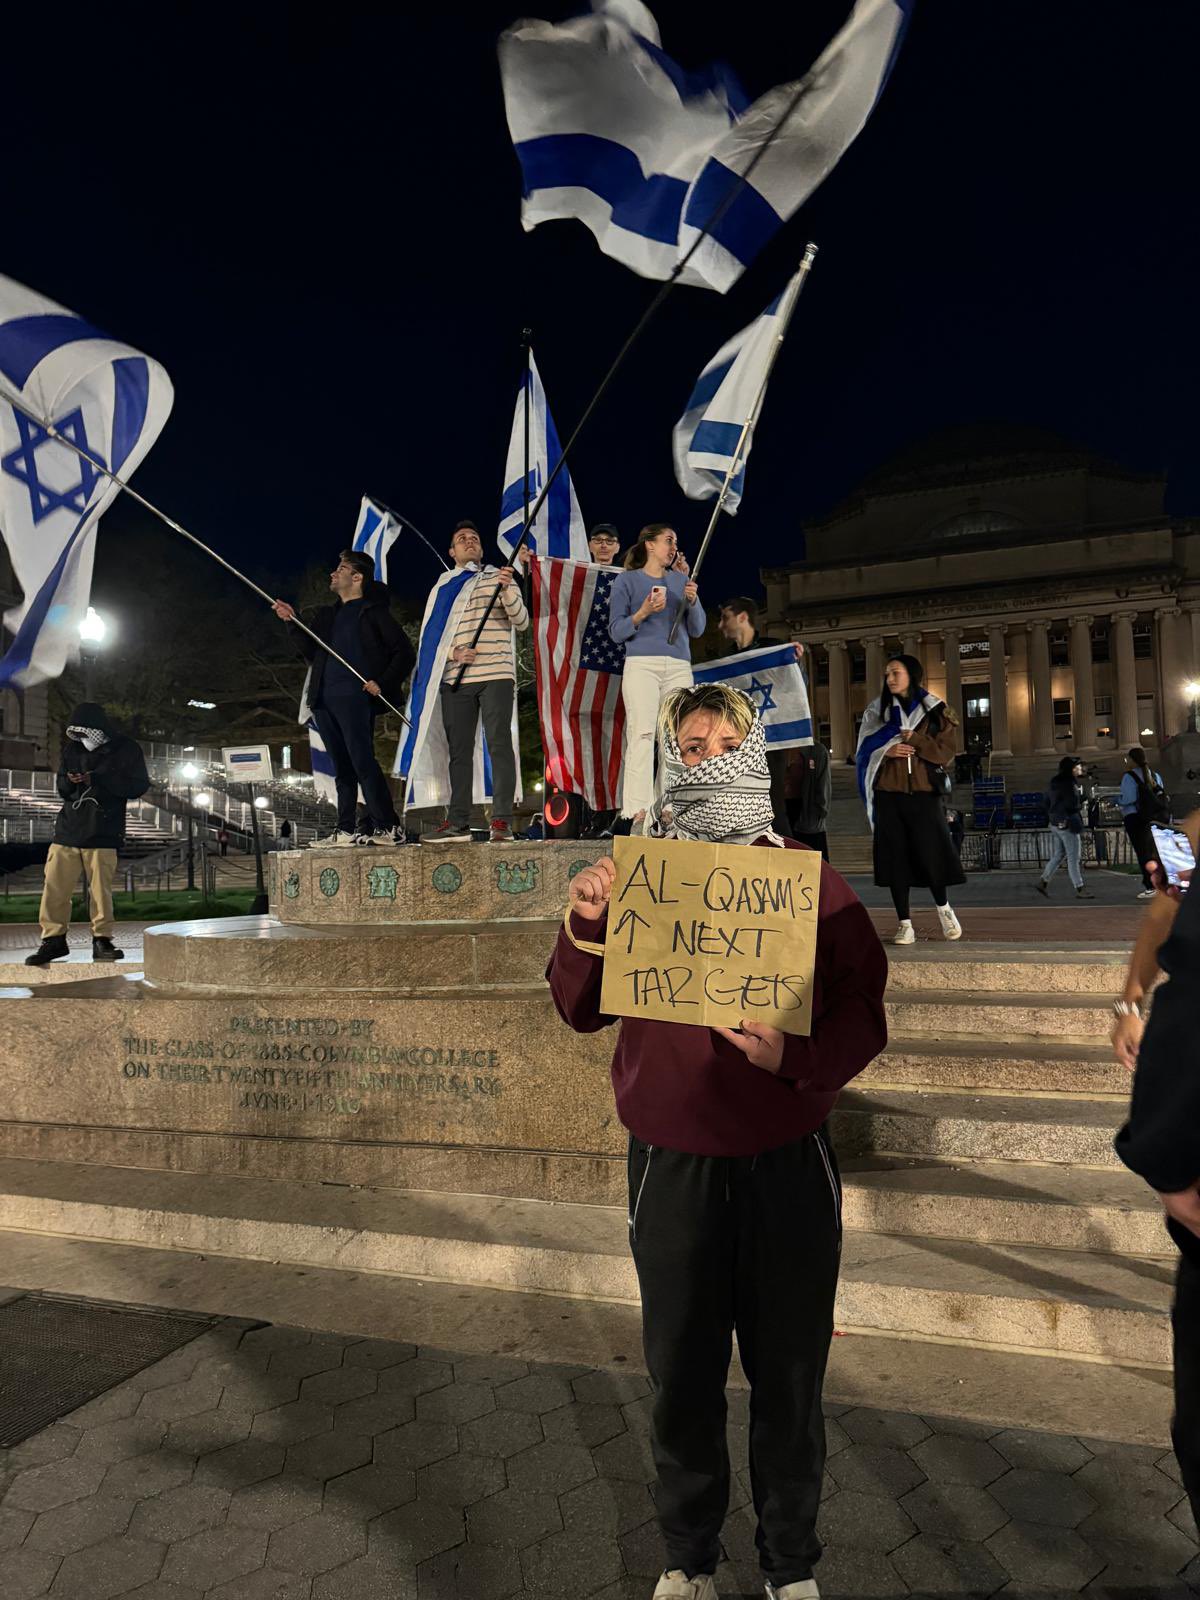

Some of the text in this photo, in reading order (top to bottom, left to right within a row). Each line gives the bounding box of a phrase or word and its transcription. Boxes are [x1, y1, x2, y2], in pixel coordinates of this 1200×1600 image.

[672, 919, 783, 957] NEXT
[230, 1016, 375, 1037] PRESENTED BY
[164, 1039, 214, 1059] CLASS
[406, 1046, 500, 1068] COLLEGE
[123, 1060, 151, 1079] ON
[156, 1062, 210, 1083] THEIR
